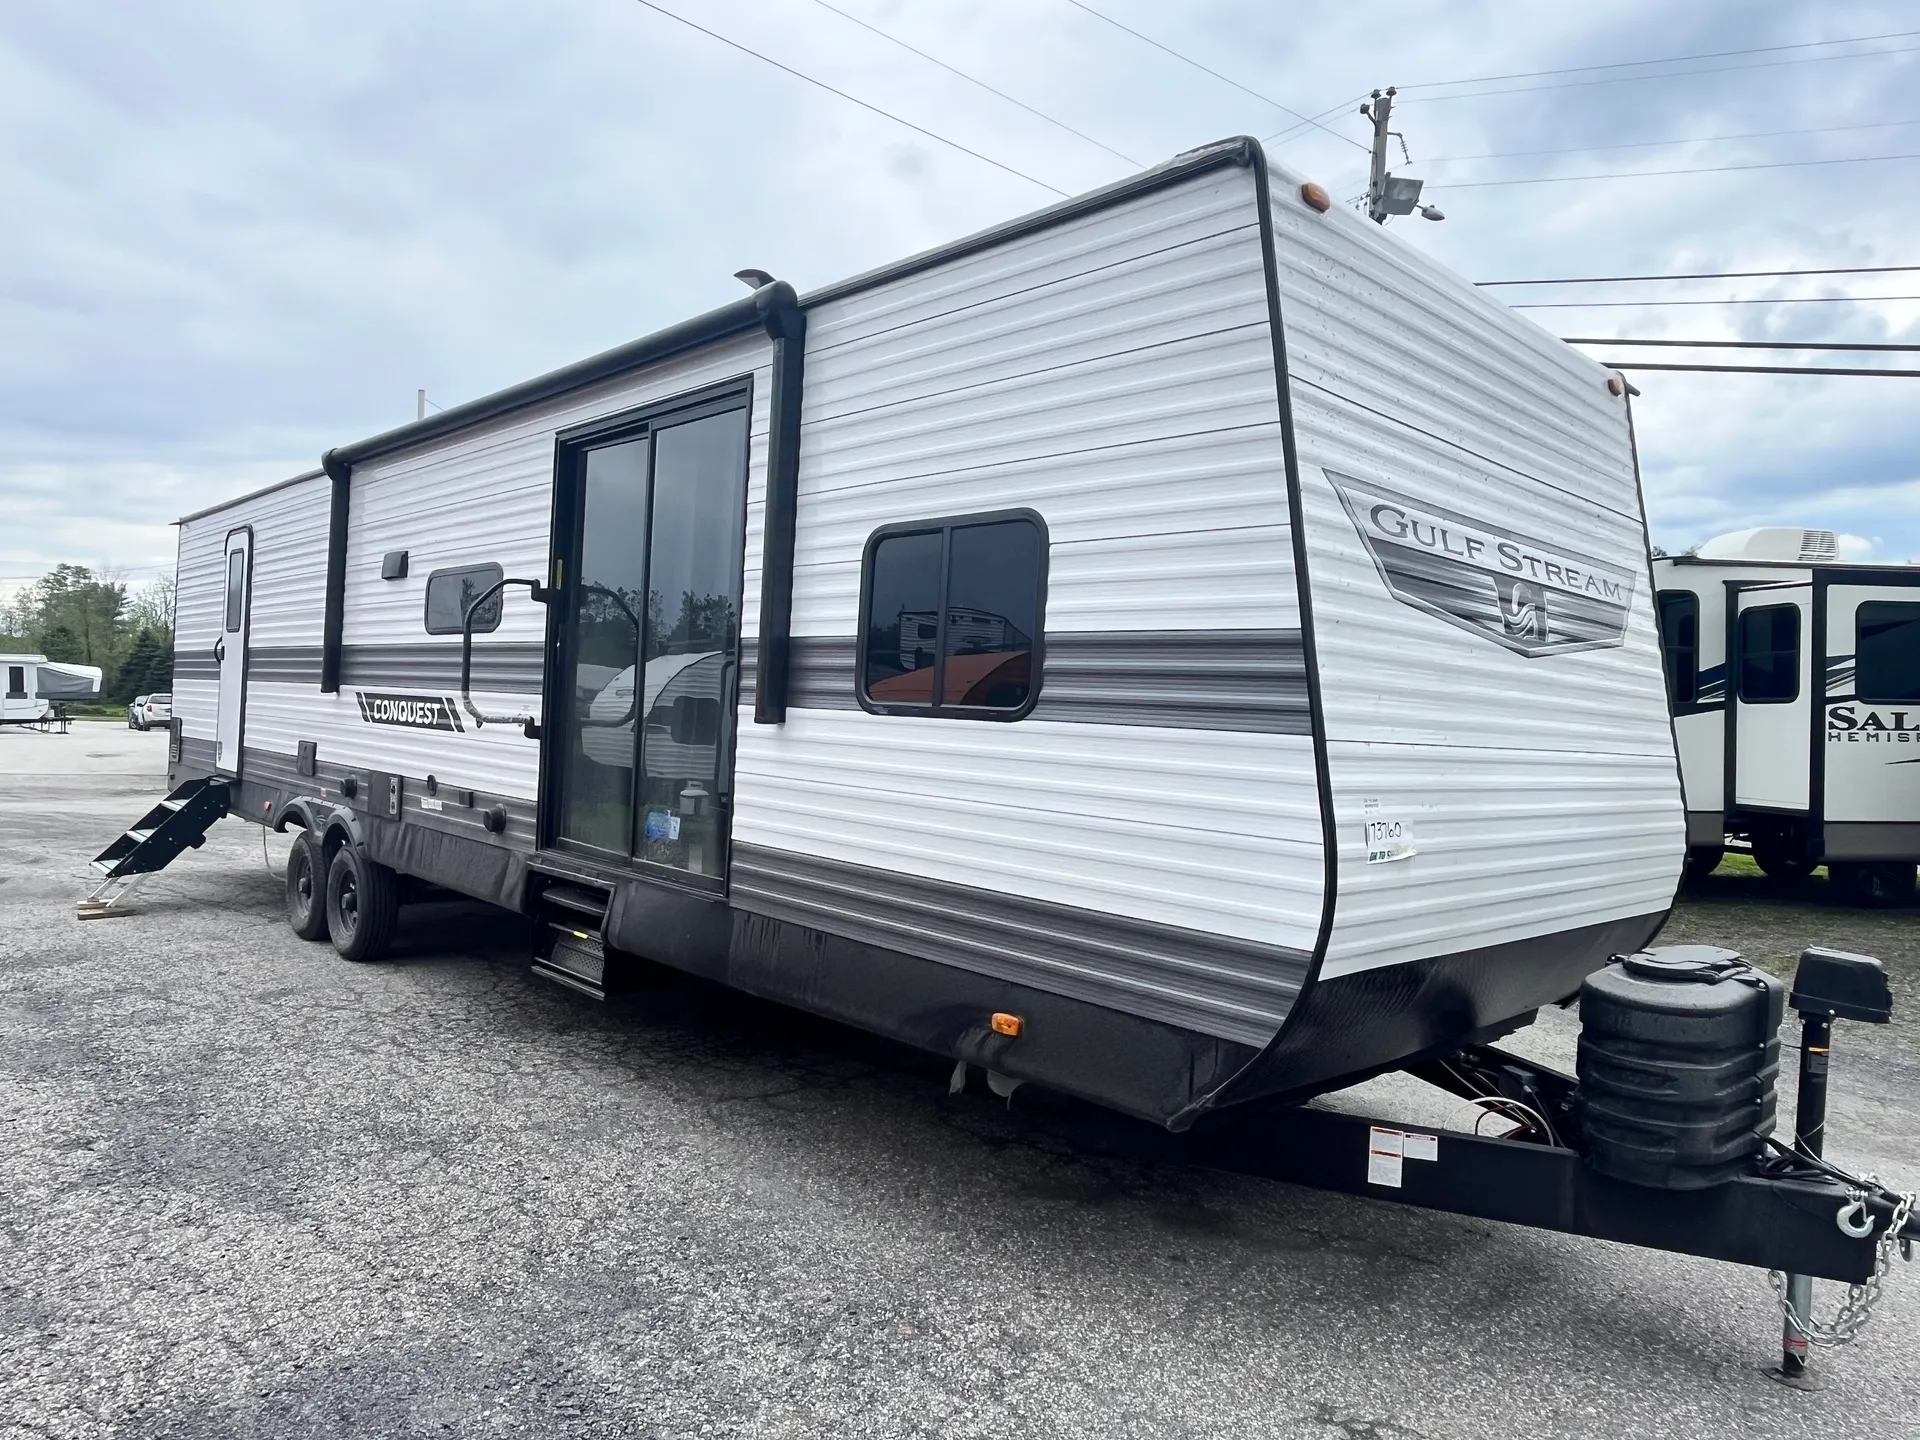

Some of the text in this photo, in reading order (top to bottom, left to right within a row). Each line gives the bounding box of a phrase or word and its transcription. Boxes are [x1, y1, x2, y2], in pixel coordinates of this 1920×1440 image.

[1370, 504, 1622, 601] GULF STREAM
[373, 699, 441, 725] CONQUEST
